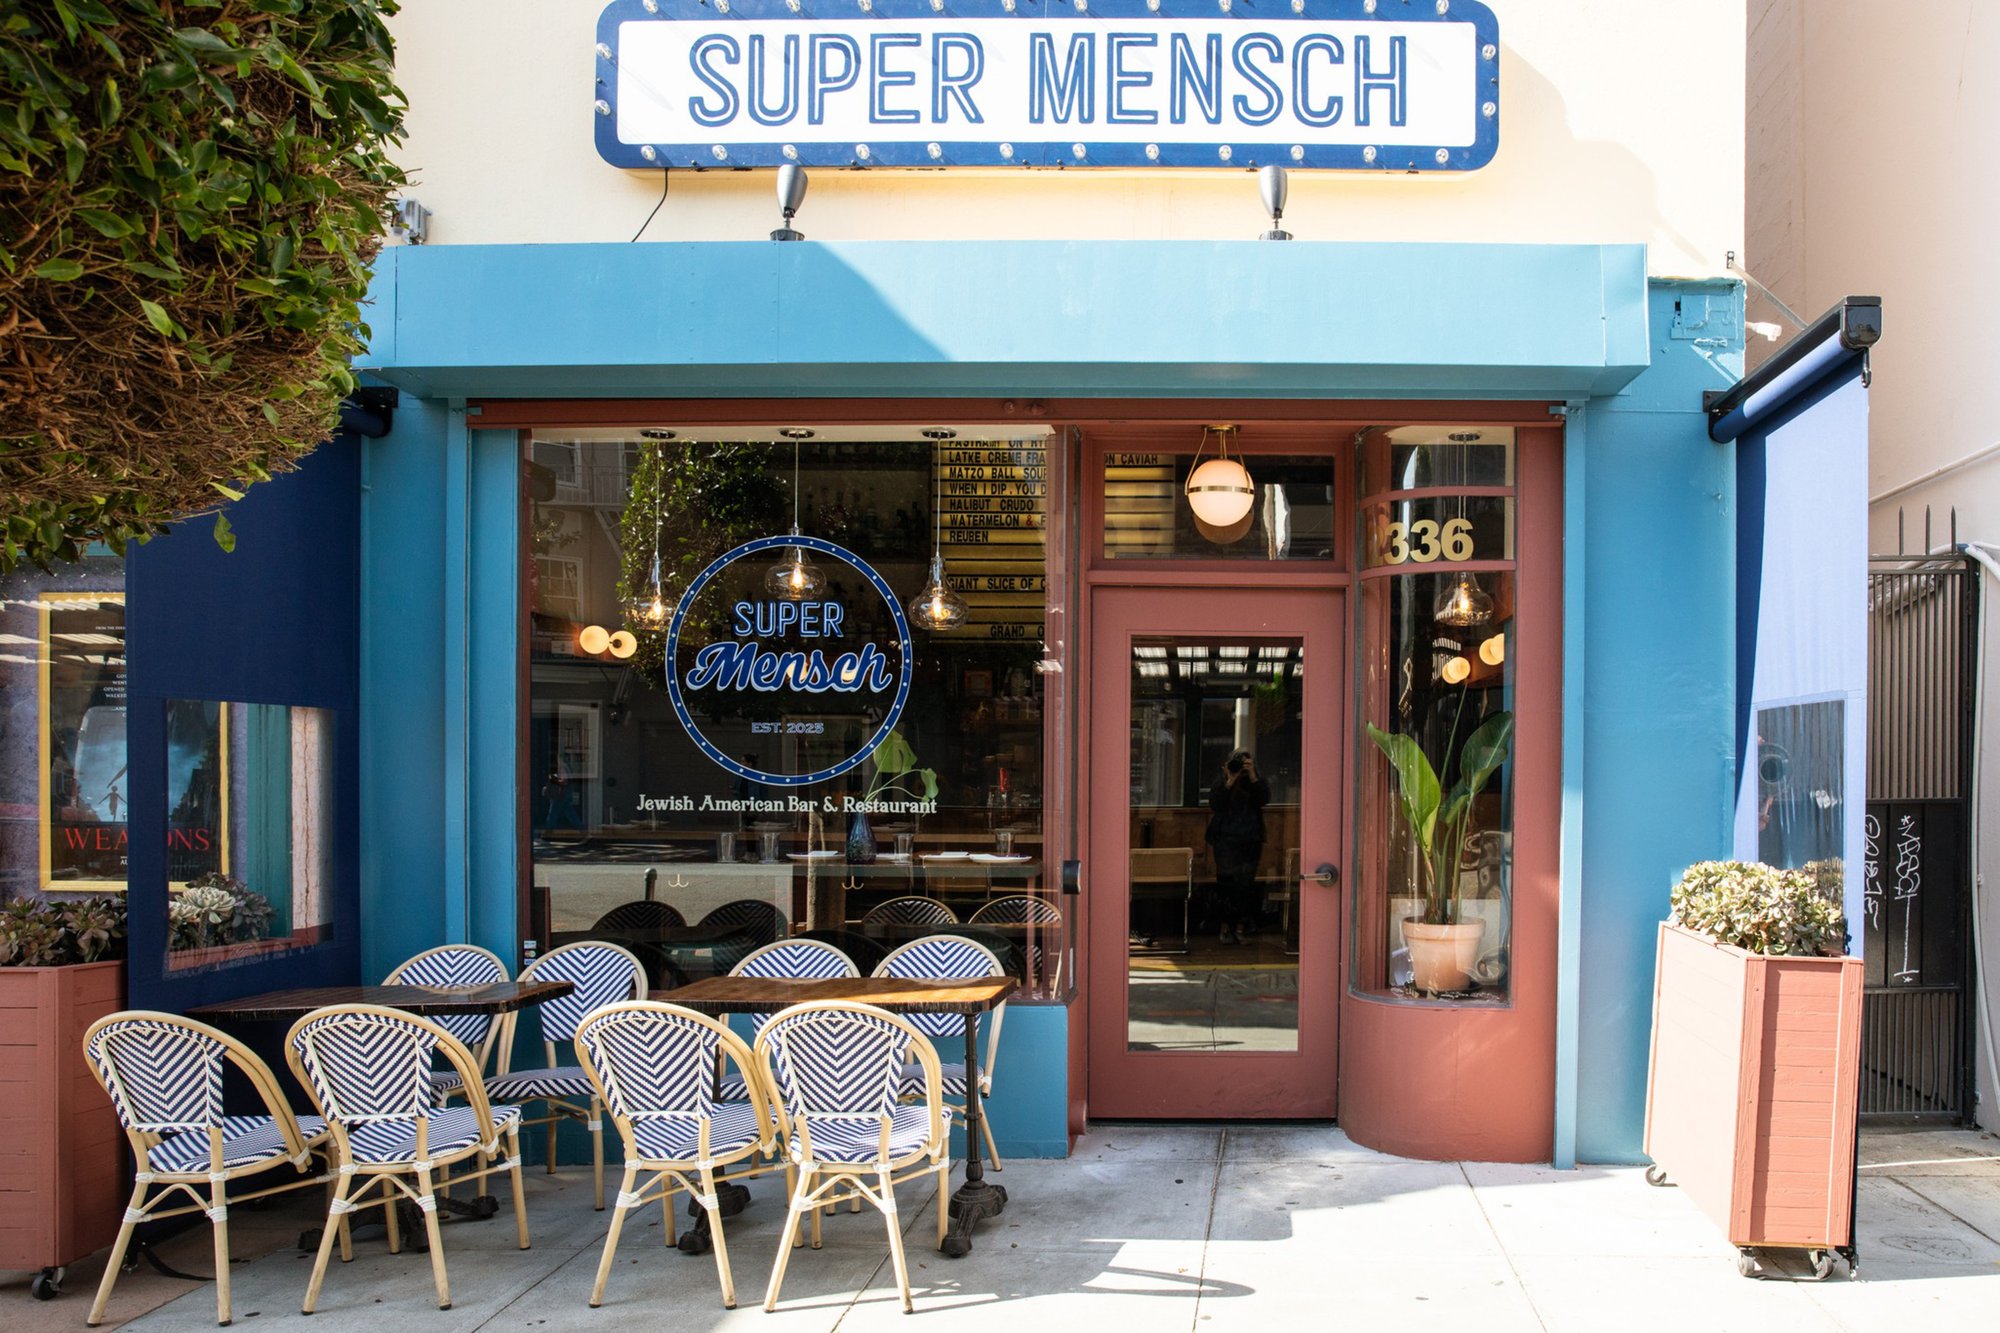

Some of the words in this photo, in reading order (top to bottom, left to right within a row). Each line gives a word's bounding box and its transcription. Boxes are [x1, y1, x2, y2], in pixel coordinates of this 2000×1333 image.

[688, 32, 985, 126] SUPER
[1029, 32, 1408, 128] MENSCH
[988, 452, 1022, 464] CREME
[1121, 454, 1158, 464] CAVIAR
[949, 468, 984, 479] MATZO
[992, 468, 1016, 479] BALL
[949, 483, 978, 494] WHEN
[983, 483, 987, 494] I
[1016, 484, 1036, 494] YOU
[949, 499, 990, 510] HALIBUT
[1000, 499, 1034, 510] CRUDO
[949, 515, 1020, 526] WATERMELON
[1025, 515, 1034, 526] &
[949, 531, 989, 542] REUBEN
[948, 578, 979, 589] GIANT
[987, 578, 1015, 589] SLICE
[1020, 578, 1034, 589] OF
[732, 600, 844, 638] SUPER
[990, 626, 1025, 638] GRAND
[686, 641, 893, 693] Mensch
[751, 722, 783, 734] EST.
[637, 795, 694, 812] Jewish
[699, 795, 784, 812] American
[788, 797, 818, 812] Bar
[823, 798, 838, 812] &
[843, 797, 937, 814] Restaurant
[64, 827, 210, 851] WEANS
